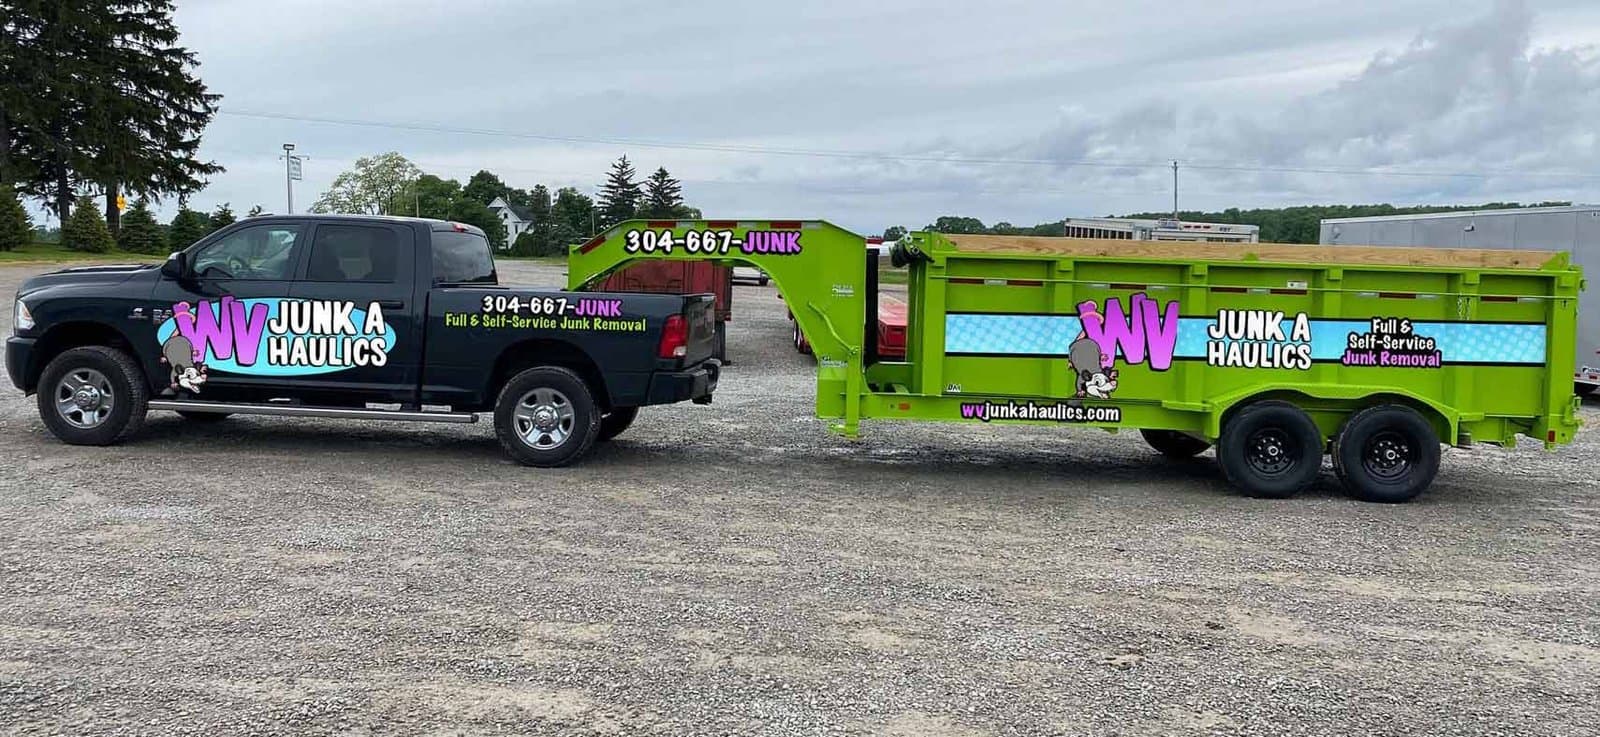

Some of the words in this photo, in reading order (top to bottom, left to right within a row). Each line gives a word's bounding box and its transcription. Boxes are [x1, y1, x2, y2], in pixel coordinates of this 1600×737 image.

[626, 230, 802, 253] 304-667-JUNK
[268, 300, 358, 335] JUNK
[364, 300, 386, 335] A
[482, 295, 623, 317] 304-667-JUNK
[172, 295, 269, 367] WV
[445, 313, 467, 327] Full
[470, 315, 480, 327] &
[482, 314, 557, 329] Self-Service
[560, 317, 590, 330] Junk
[593, 318, 646, 332] Removal
[1077, 293, 1180, 371] WV
[1208, 309, 1286, 341] JUNK
[1291, 312, 1312, 342] A
[1372, 318, 1397, 334] Full
[1400, 320, 1411, 334] &
[268, 336, 388, 367] HAULICS
[1349, 334, 1434, 350] Self-Service
[1208, 341, 1312, 370] HAULICS
[1343, 350, 1377, 365] Junk
[1380, 351, 1440, 367] Removal
[961, 402, 1120, 421] wvjunkahaulics.com
